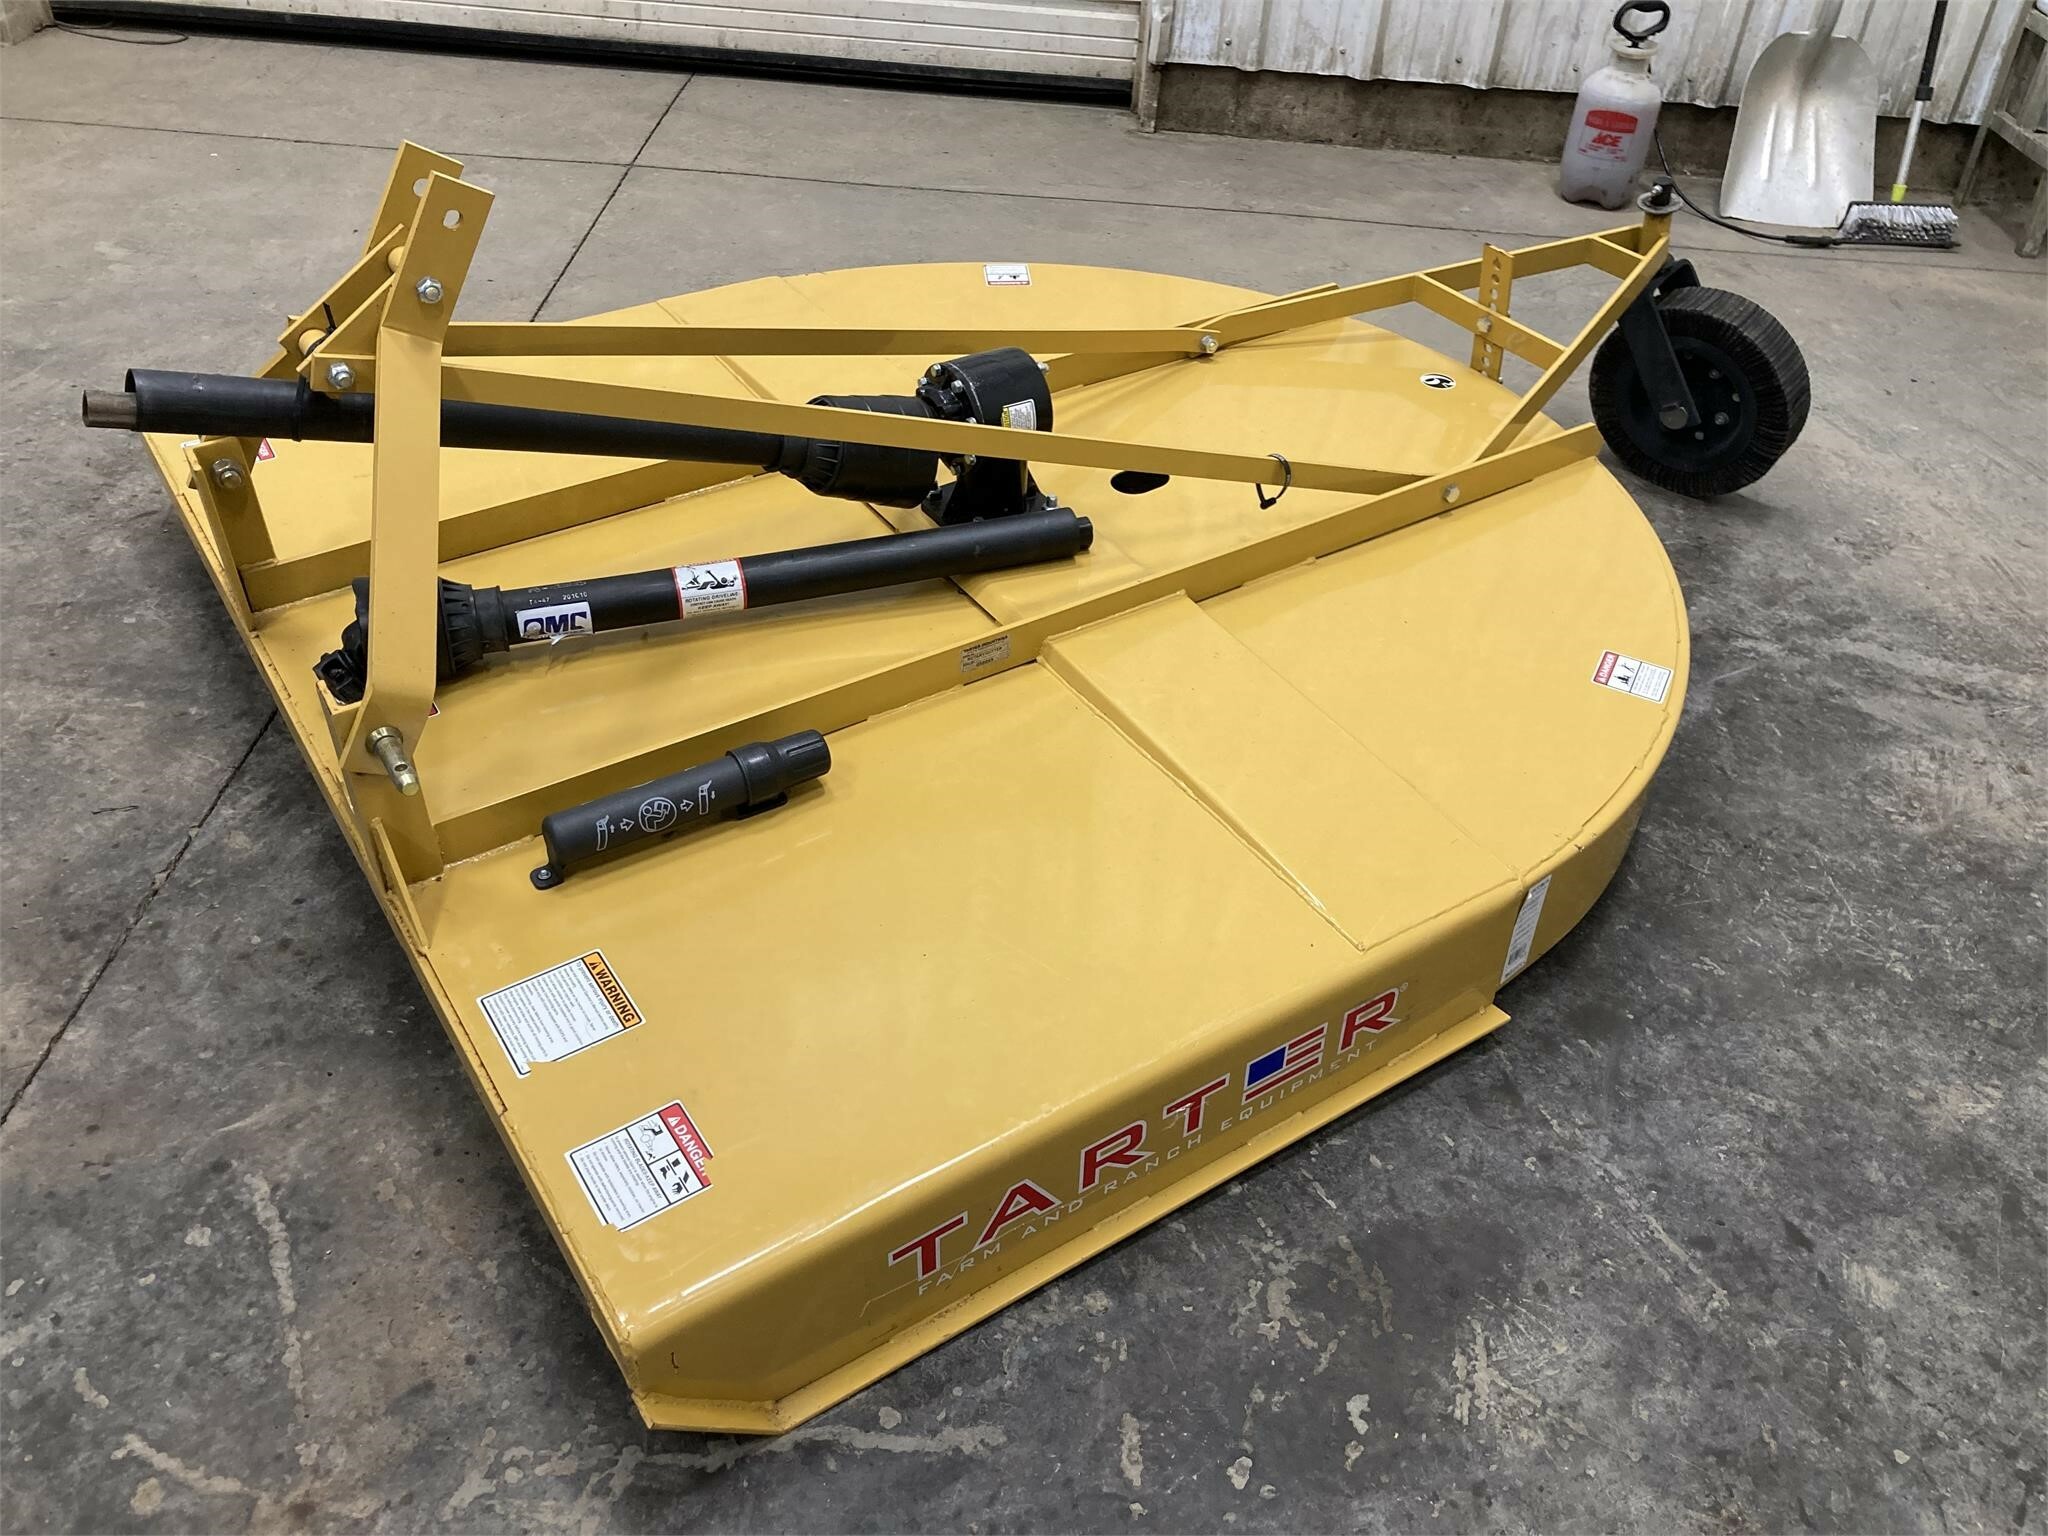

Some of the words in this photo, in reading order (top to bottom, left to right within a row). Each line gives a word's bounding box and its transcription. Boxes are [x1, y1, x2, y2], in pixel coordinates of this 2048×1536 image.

[595, 968, 635, 1024] WARNING
[919, 1246, 1002, 1296] FARM
[1022, 1199, 1084, 1240] AND
[1104, 1135, 1202, 1195] RANCH
[1221, 1040, 1378, 1132] EQUIPMENT
